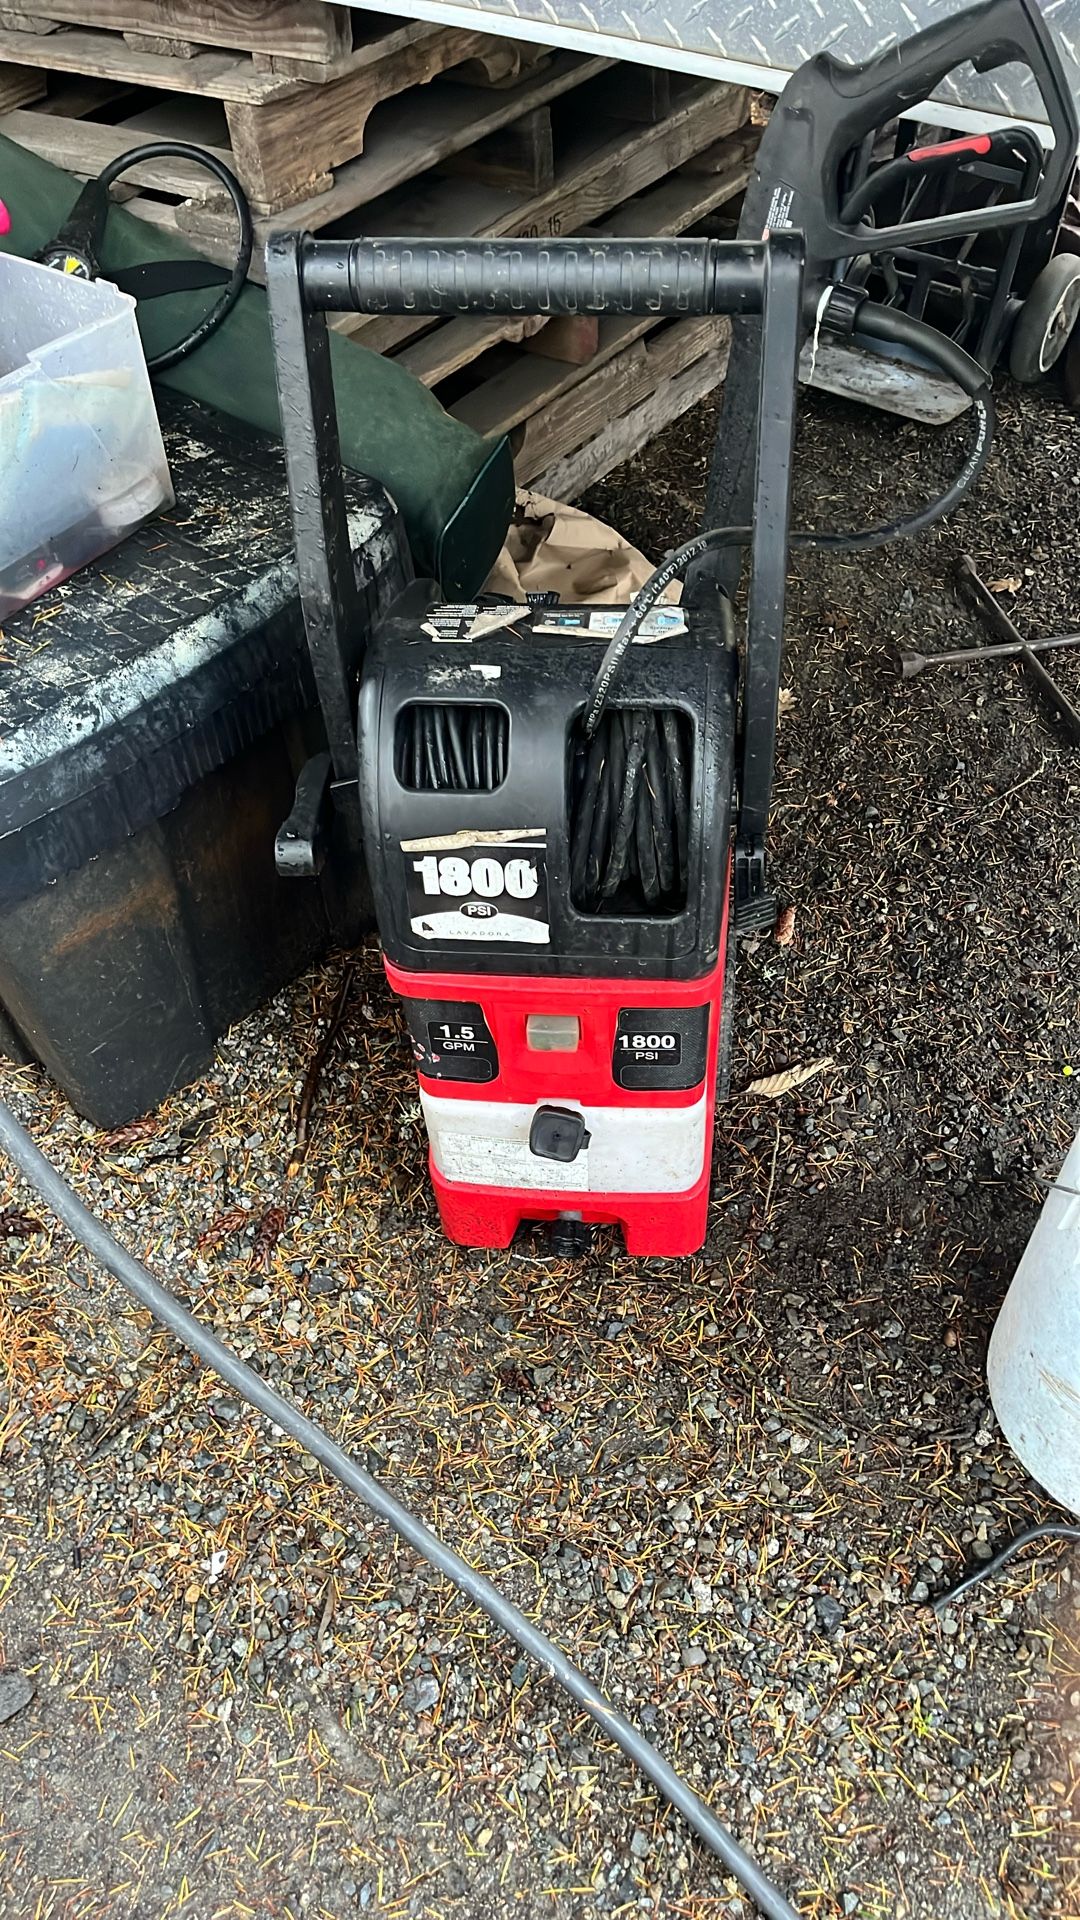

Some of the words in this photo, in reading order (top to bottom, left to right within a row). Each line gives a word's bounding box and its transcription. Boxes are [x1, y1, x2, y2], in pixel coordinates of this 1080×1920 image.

[614, 629, 633, 656] Max
[413, 855, 539, 899] 1800
[467, 905, 492, 917] PSI
[449, 929, 511, 937] LAVADORA
[439, 1025, 475, 1040] 1.5
[442, 1041, 475, 1052] GPM
[618, 1035, 676, 1049] 1800
[635, 1051, 659, 1060] PSI
